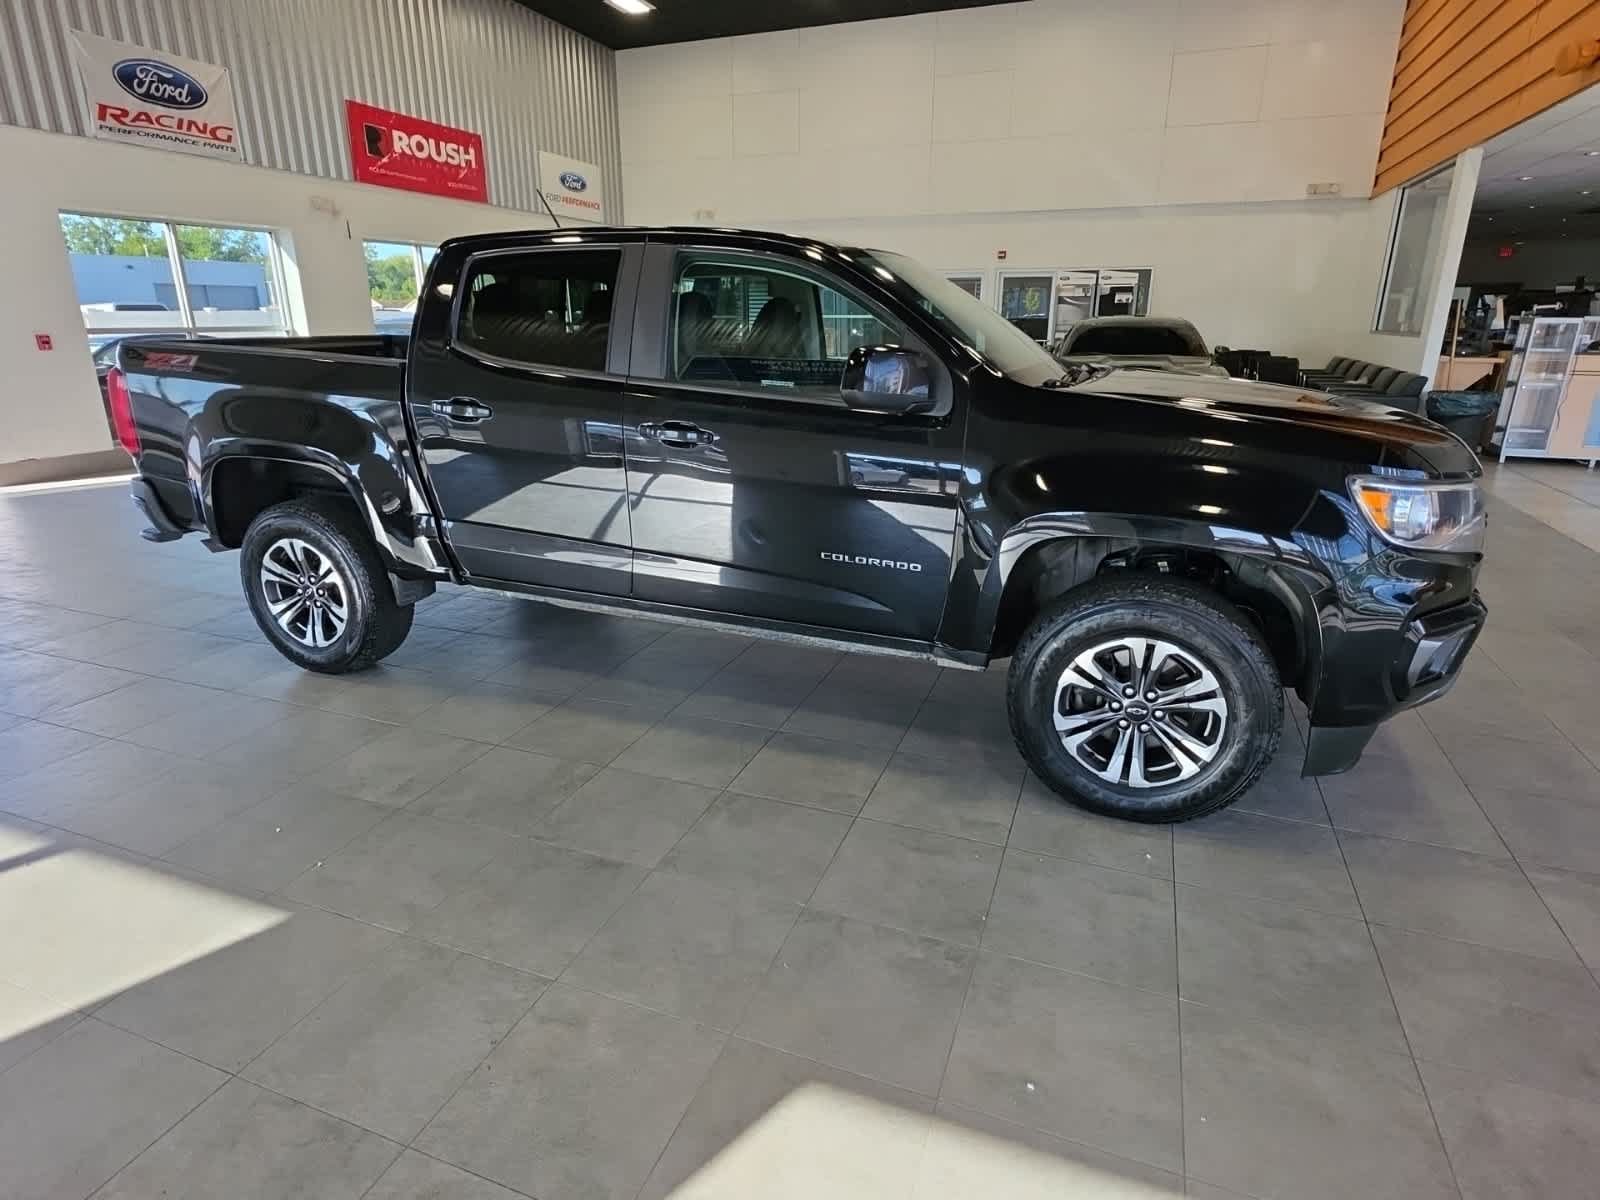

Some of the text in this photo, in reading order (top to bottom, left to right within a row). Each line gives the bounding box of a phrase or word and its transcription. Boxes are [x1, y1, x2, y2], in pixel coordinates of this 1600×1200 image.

[133, 65, 192, 104] Ford
[96, 102, 233, 144] RACING
[99, 124, 237, 153] PERFORMANCE PARTS
[391, 129, 476, 169] ROUSH
[820, 551, 922, 572] COLORADO
